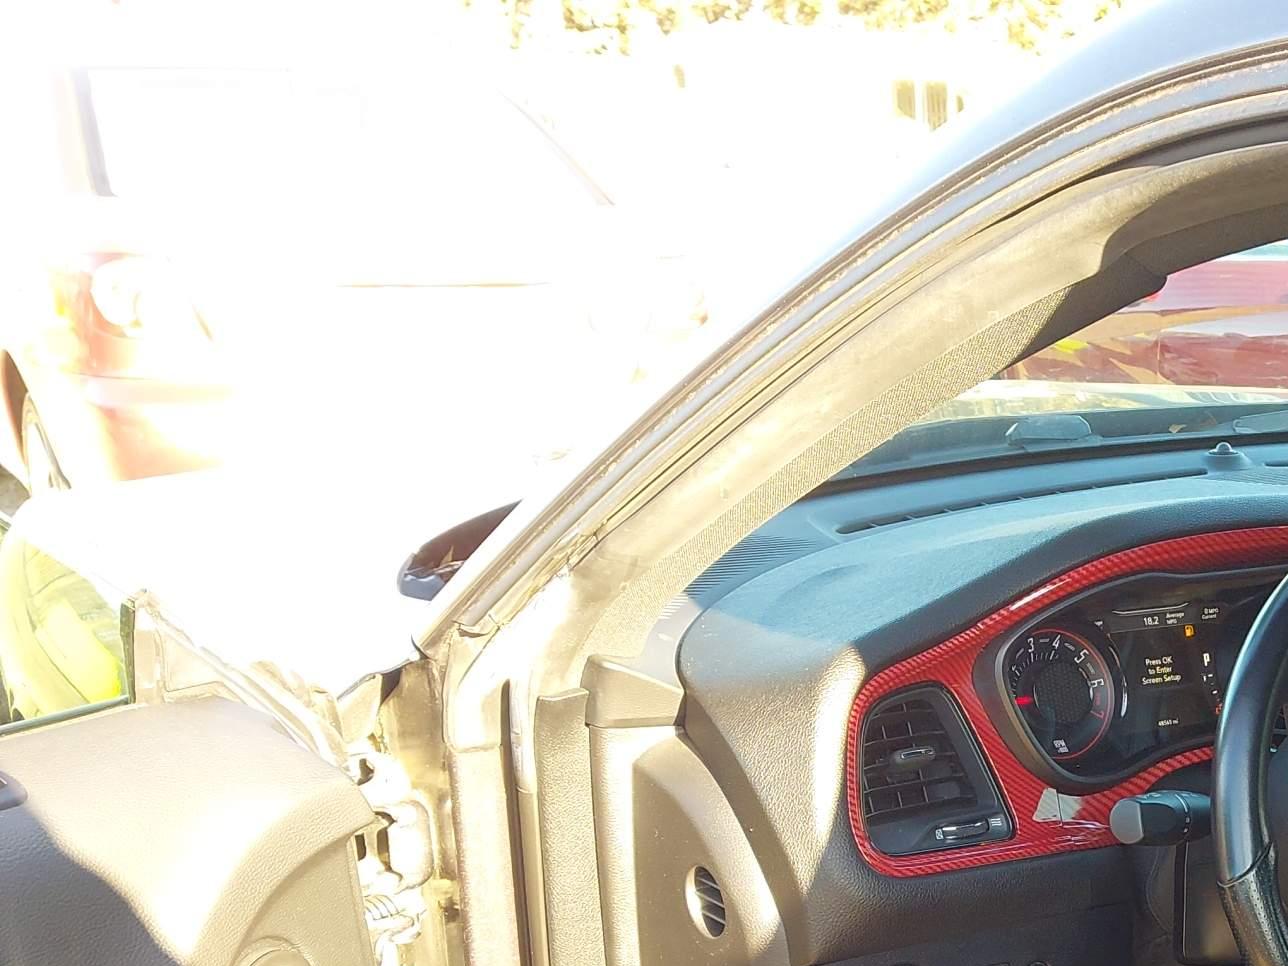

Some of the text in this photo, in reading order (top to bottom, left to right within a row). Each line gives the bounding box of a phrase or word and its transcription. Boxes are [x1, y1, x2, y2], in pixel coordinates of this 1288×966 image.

[1143, 616, 1160, 626] 18.2
[1027, 637, 1035, 653] 3
[1074, 649, 1089, 664] 5
[1145, 656, 1173, 667] Press OK
[1203, 653, 1210, 667] P
[1148, 666, 1172, 676] to Enter
[1142, 674, 1182, 686] Screen Setup
